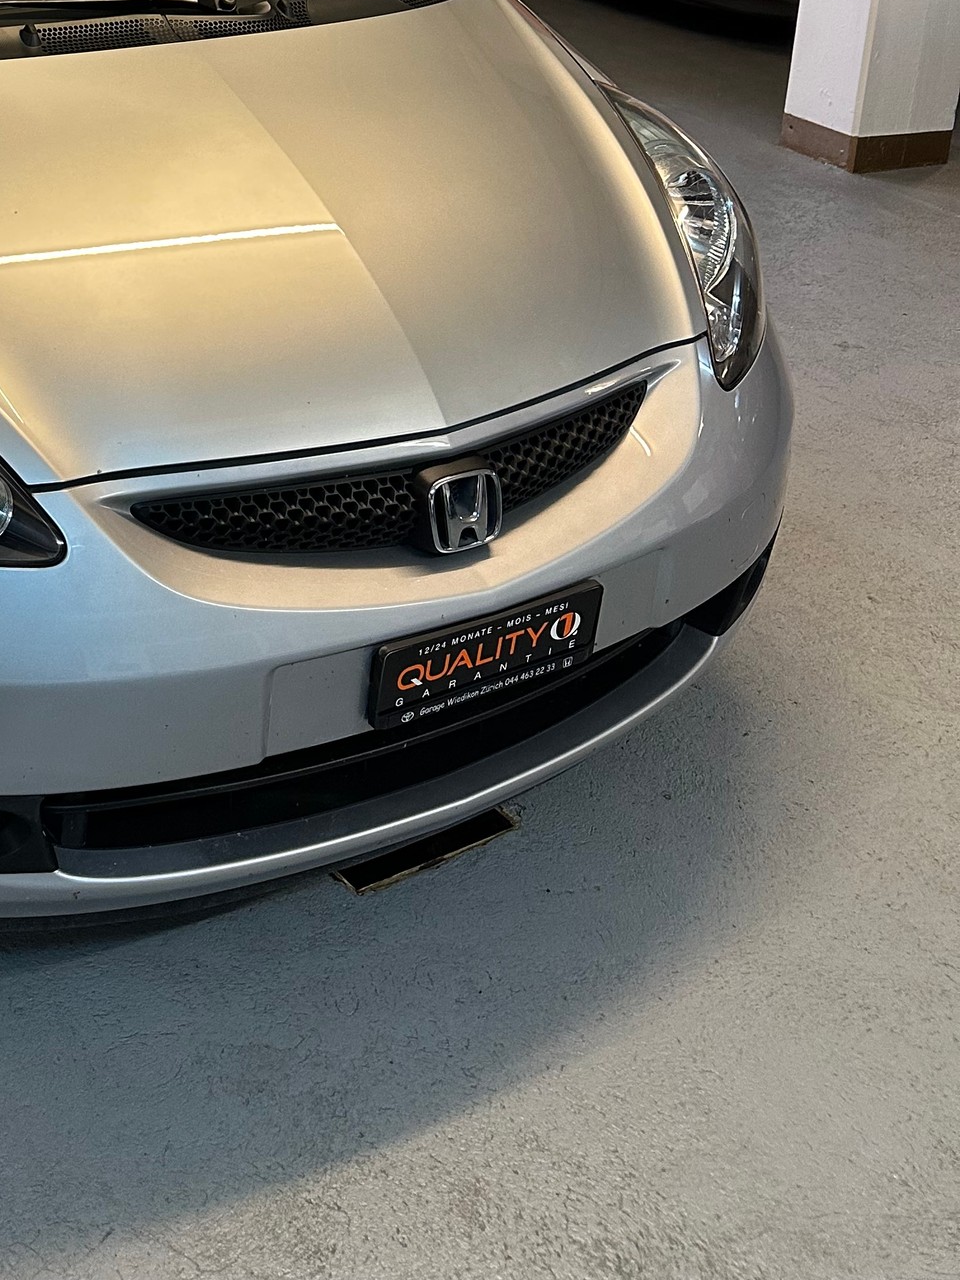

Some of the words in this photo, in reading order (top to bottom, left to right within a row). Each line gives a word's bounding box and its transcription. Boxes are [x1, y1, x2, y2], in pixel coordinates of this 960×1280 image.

[396, 621, 549, 690] QUALITY
[419, 640, 447, 656] 12/24
[452, 626, 493, 646] MONATE
[506, 613, 532, 628] MOIS
[545, 602, 569, 615] MESI
[395, 639, 576, 707] GARANTIE
[419, 702, 445, 716] Garage
[447, 689, 479, 707] Wiedikon
[504, 674, 519, 686] 044
[520, 670, 534, 680] 463
[535, 666, 545, 676] 22
[546, 662, 556, 672] 33
